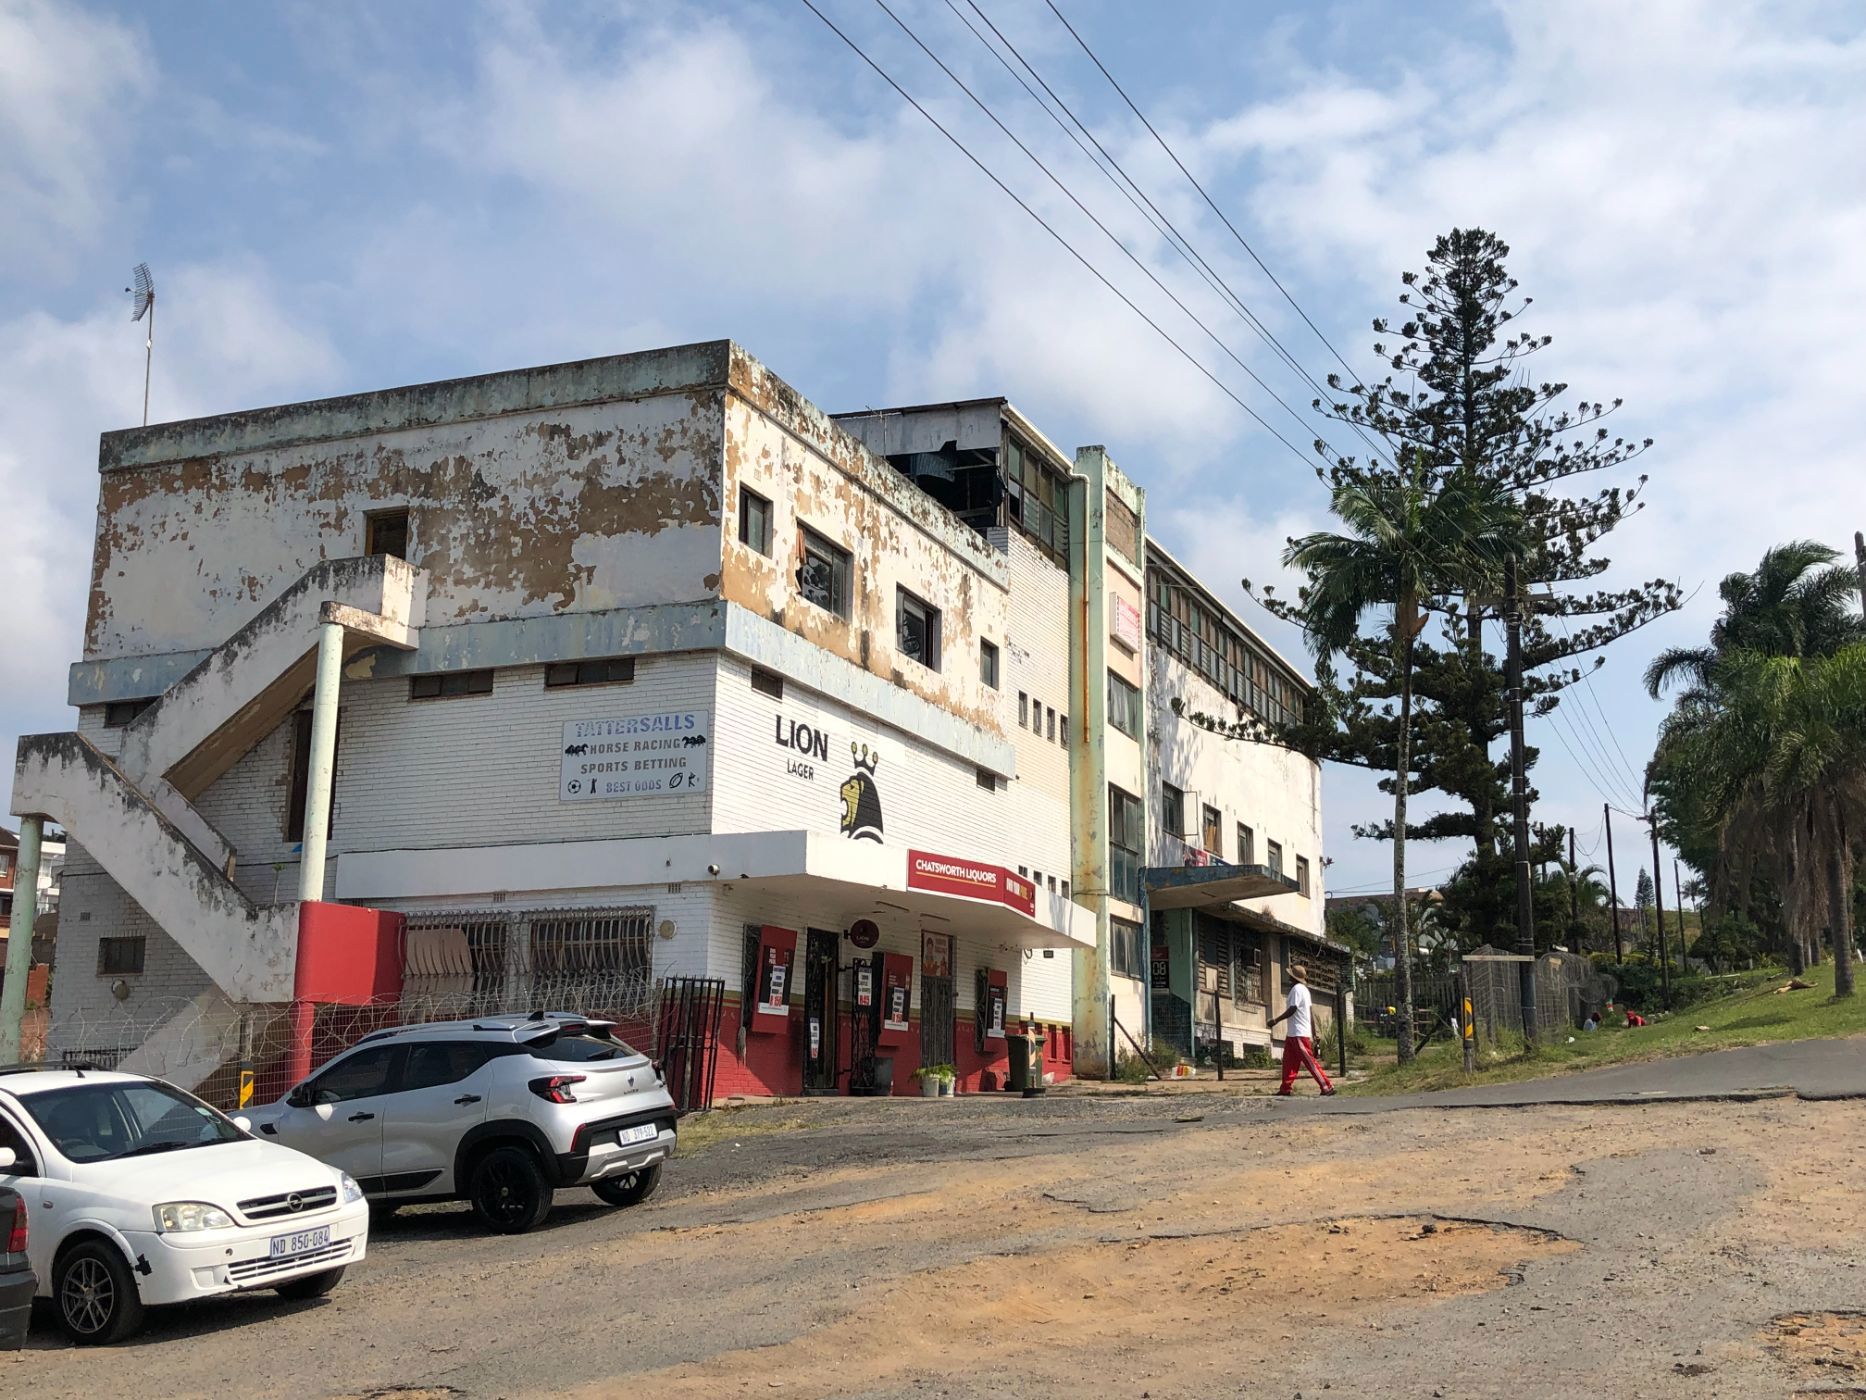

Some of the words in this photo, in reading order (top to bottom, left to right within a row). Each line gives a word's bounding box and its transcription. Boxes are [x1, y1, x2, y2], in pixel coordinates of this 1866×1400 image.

[576, 714, 695, 737] TATTERSALLS
[590, 742, 629, 755] HORSE
[634, 738, 681, 751] RACING
[776, 714, 829, 762] LION
[580, 761, 628, 774] SPORTS
[634, 757, 687, 771] BETTING
[787, 758, 815, 781] LAGER
[606, 781, 631, 793] BEST
[915, 859, 965, 879] CHATSWORTH
[966, 868, 997, 884] LIQUORS
[272, 1239, 286, 1255] ND
[291, 1230, 329, 1252] 850-084
